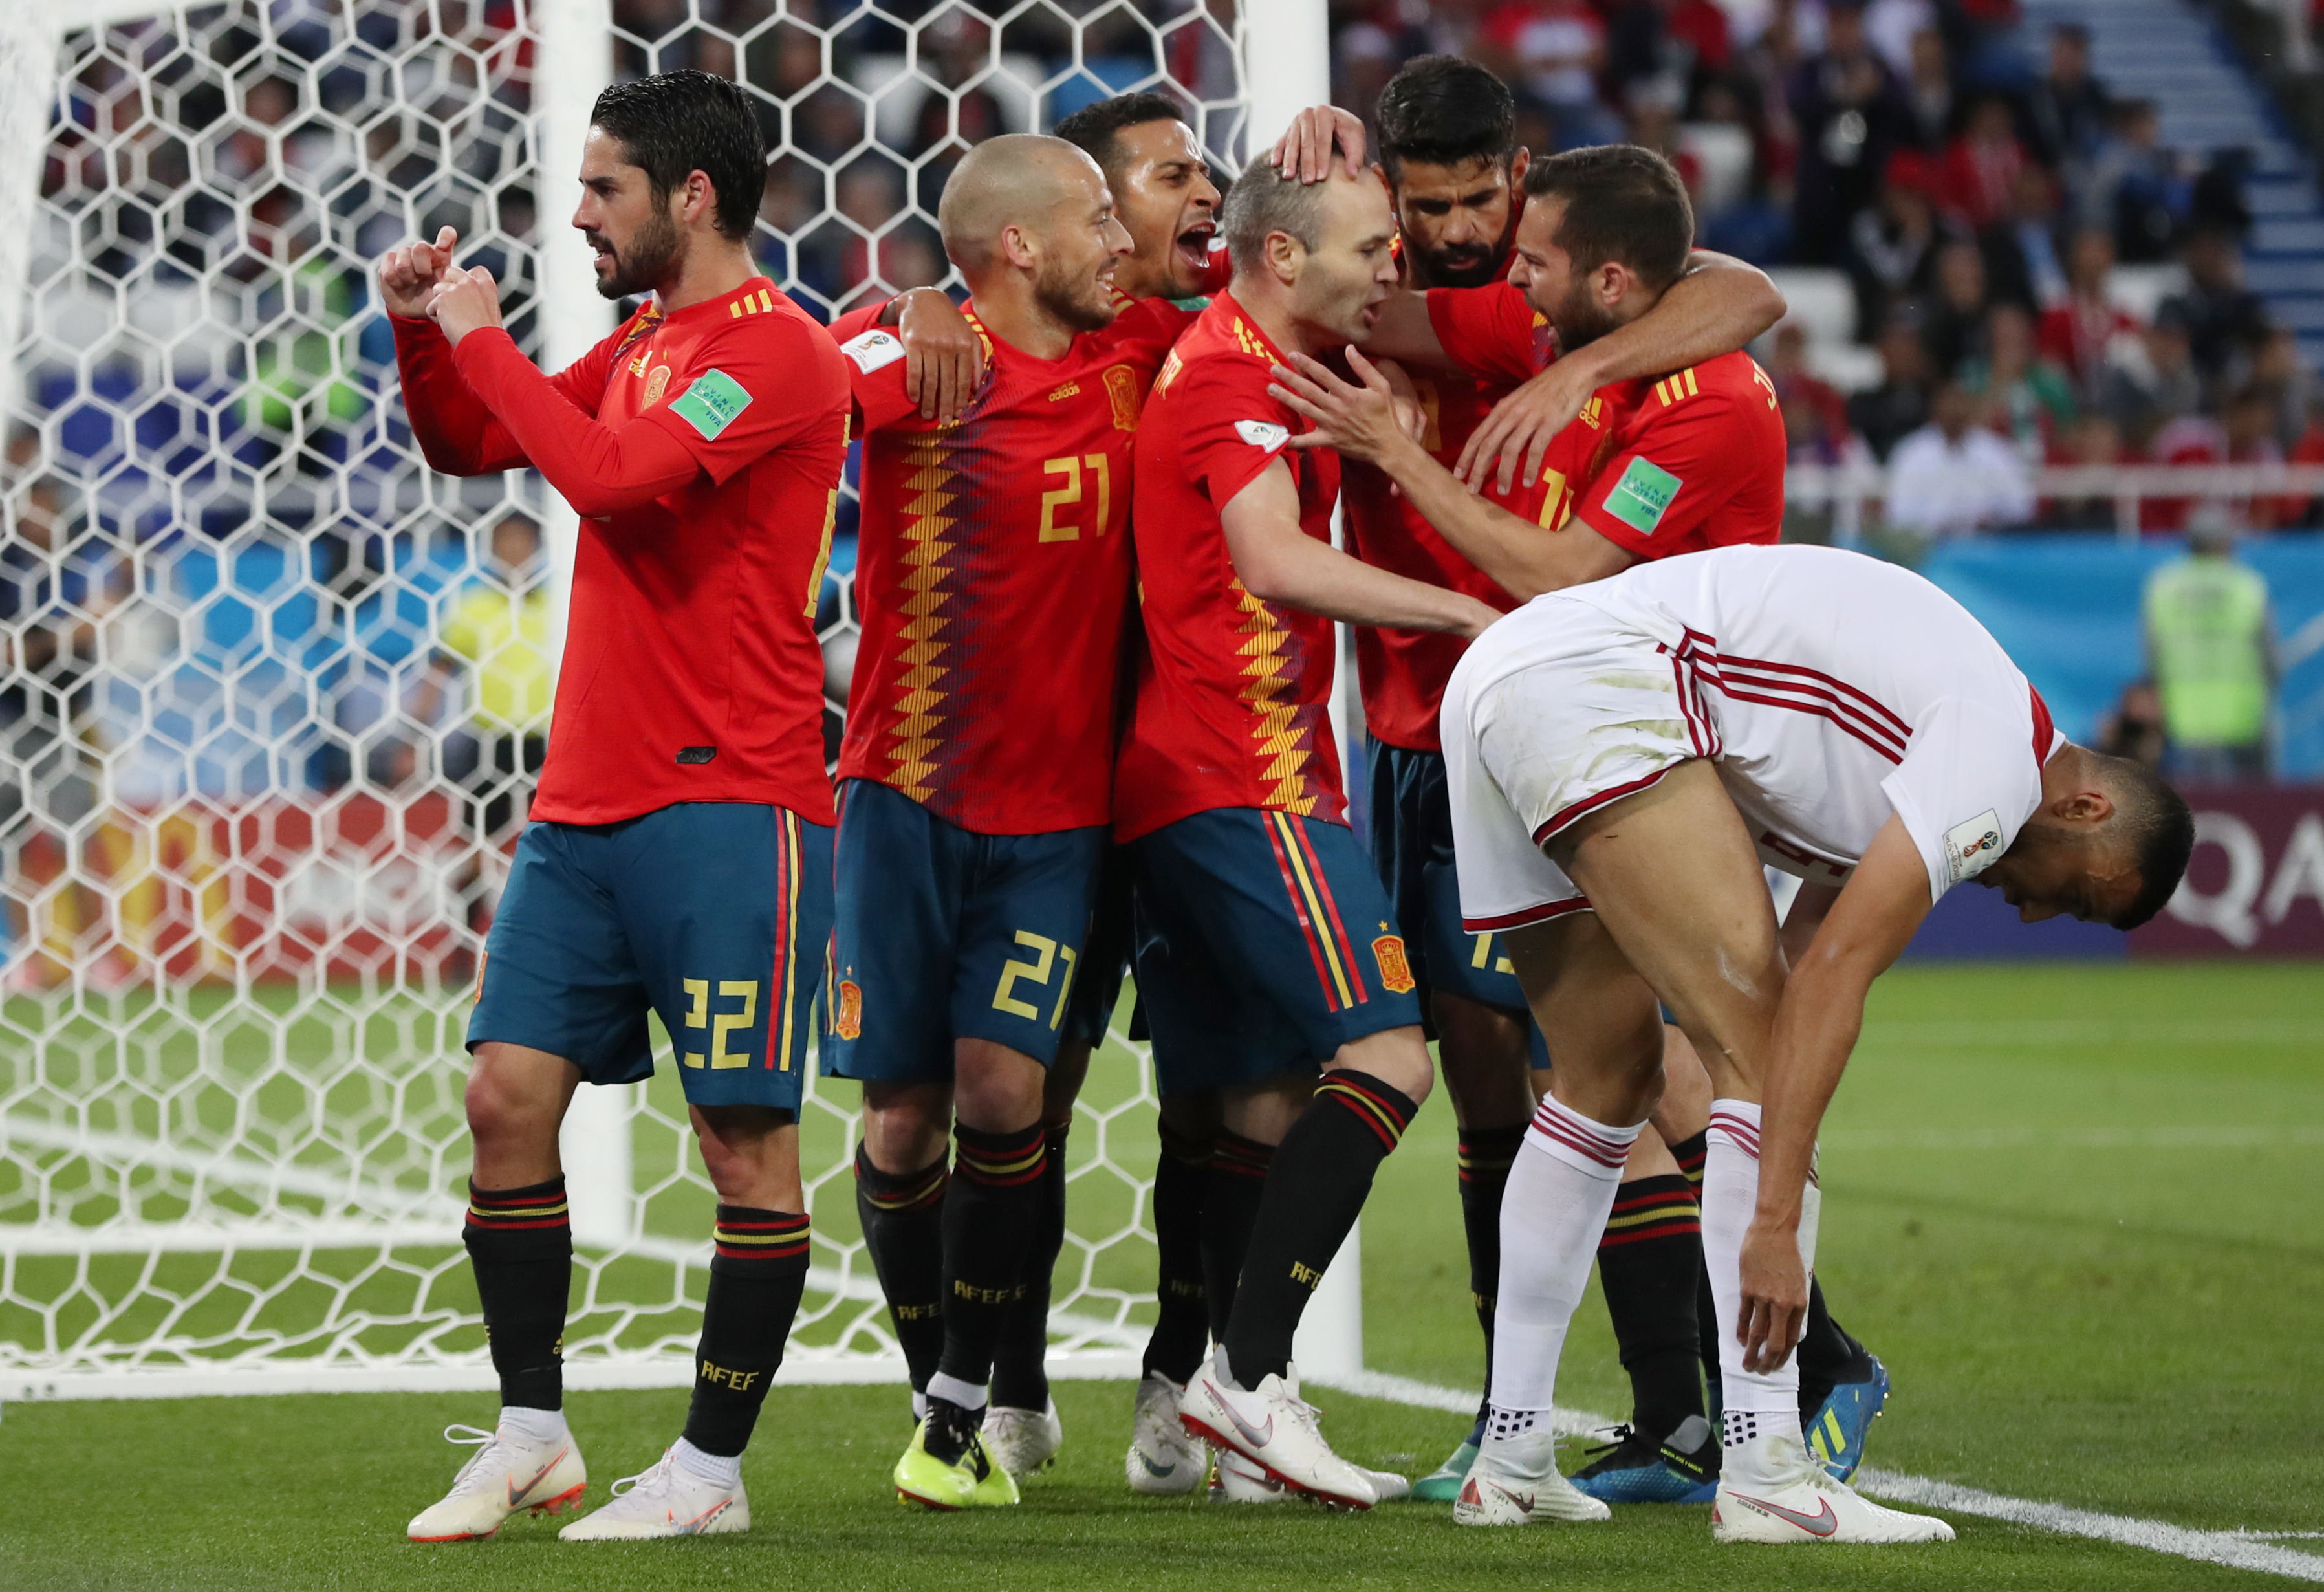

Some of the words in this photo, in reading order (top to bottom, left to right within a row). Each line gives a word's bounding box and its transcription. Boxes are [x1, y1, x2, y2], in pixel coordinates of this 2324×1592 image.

[698, 380, 735, 413] LIVING
[1048, 384, 1080, 402] adidas
[706, 411, 721, 427] FIFA
[1039, 452, 1111, 543] 21
[1641, 505, 1657, 518] FIFA
[992, 930, 1077, 1031] 21
[683, 977, 759, 1069] 22
[1289, 1261, 1323, 1291] RFE
[954, 1279, 1010, 1305] RFEF
[897, 1302, 940, 1320] RFE
[700, 1359, 760, 1391] RFEF
